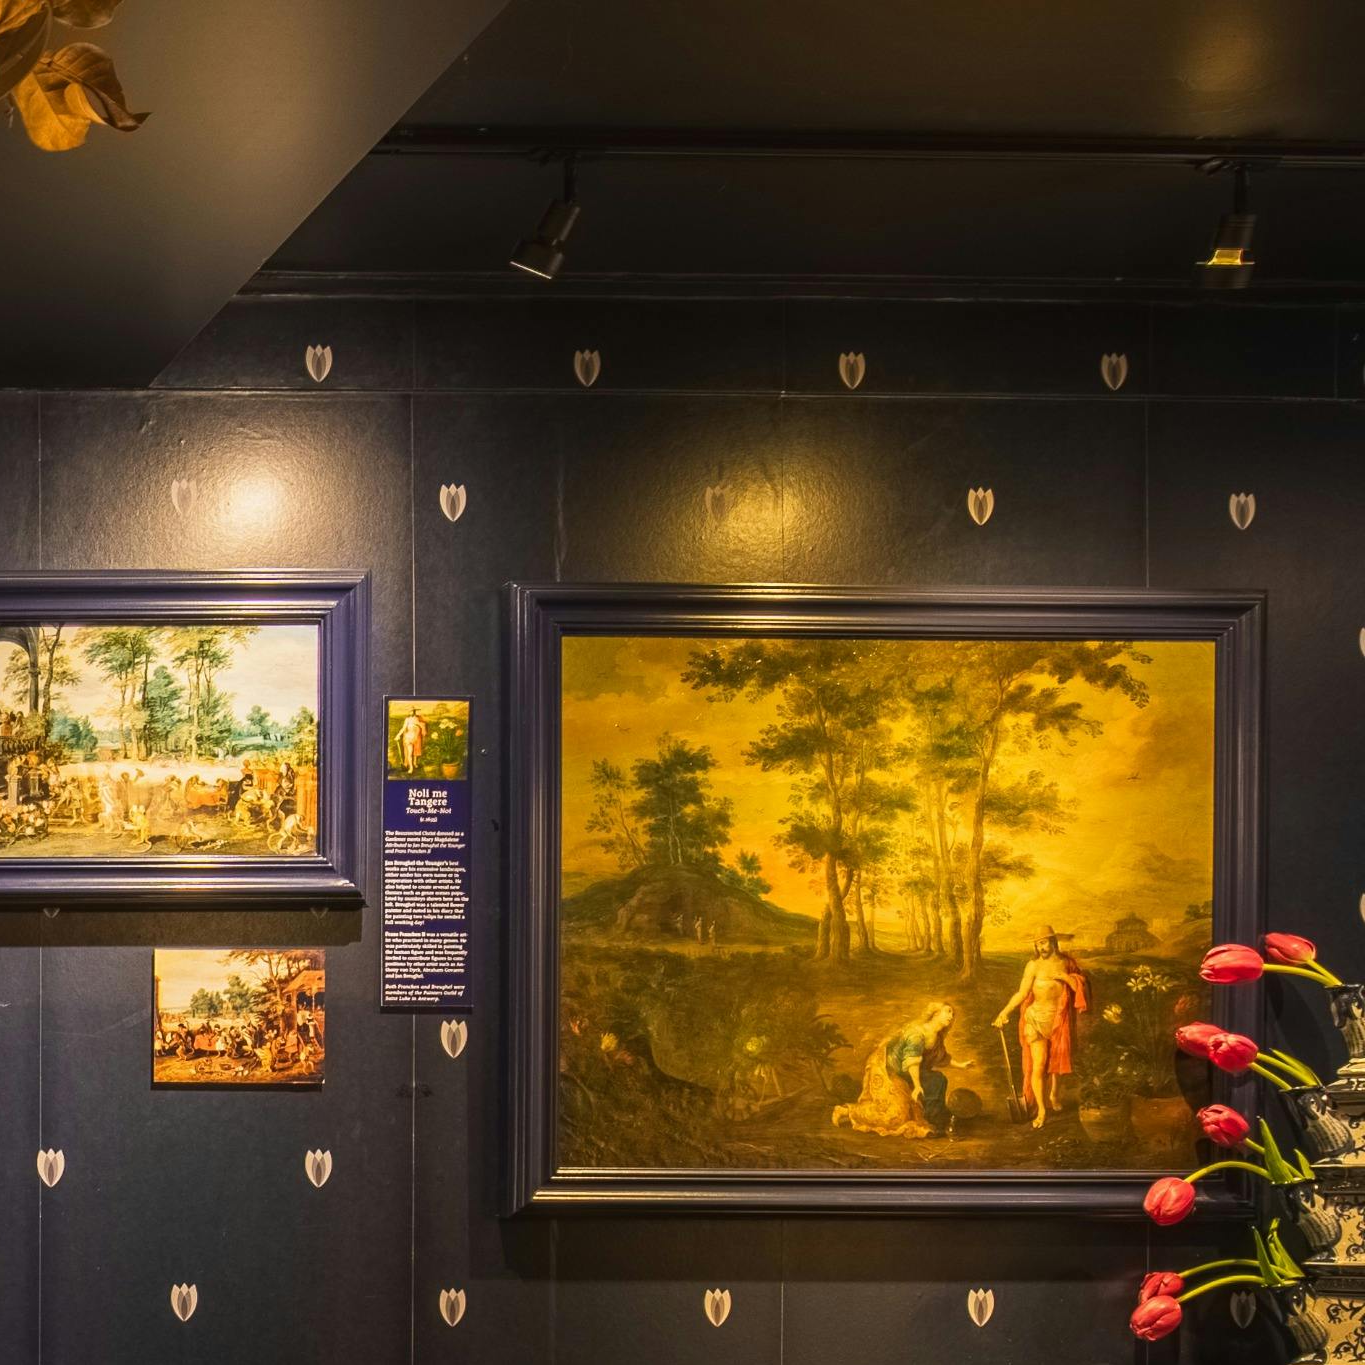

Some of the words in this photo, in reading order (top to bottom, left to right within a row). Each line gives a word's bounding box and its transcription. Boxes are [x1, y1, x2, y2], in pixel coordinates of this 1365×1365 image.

[408, 789, 429, 797] Noli
[432, 789, 447, 797] me
[409, 798, 447, 807] Tangere
